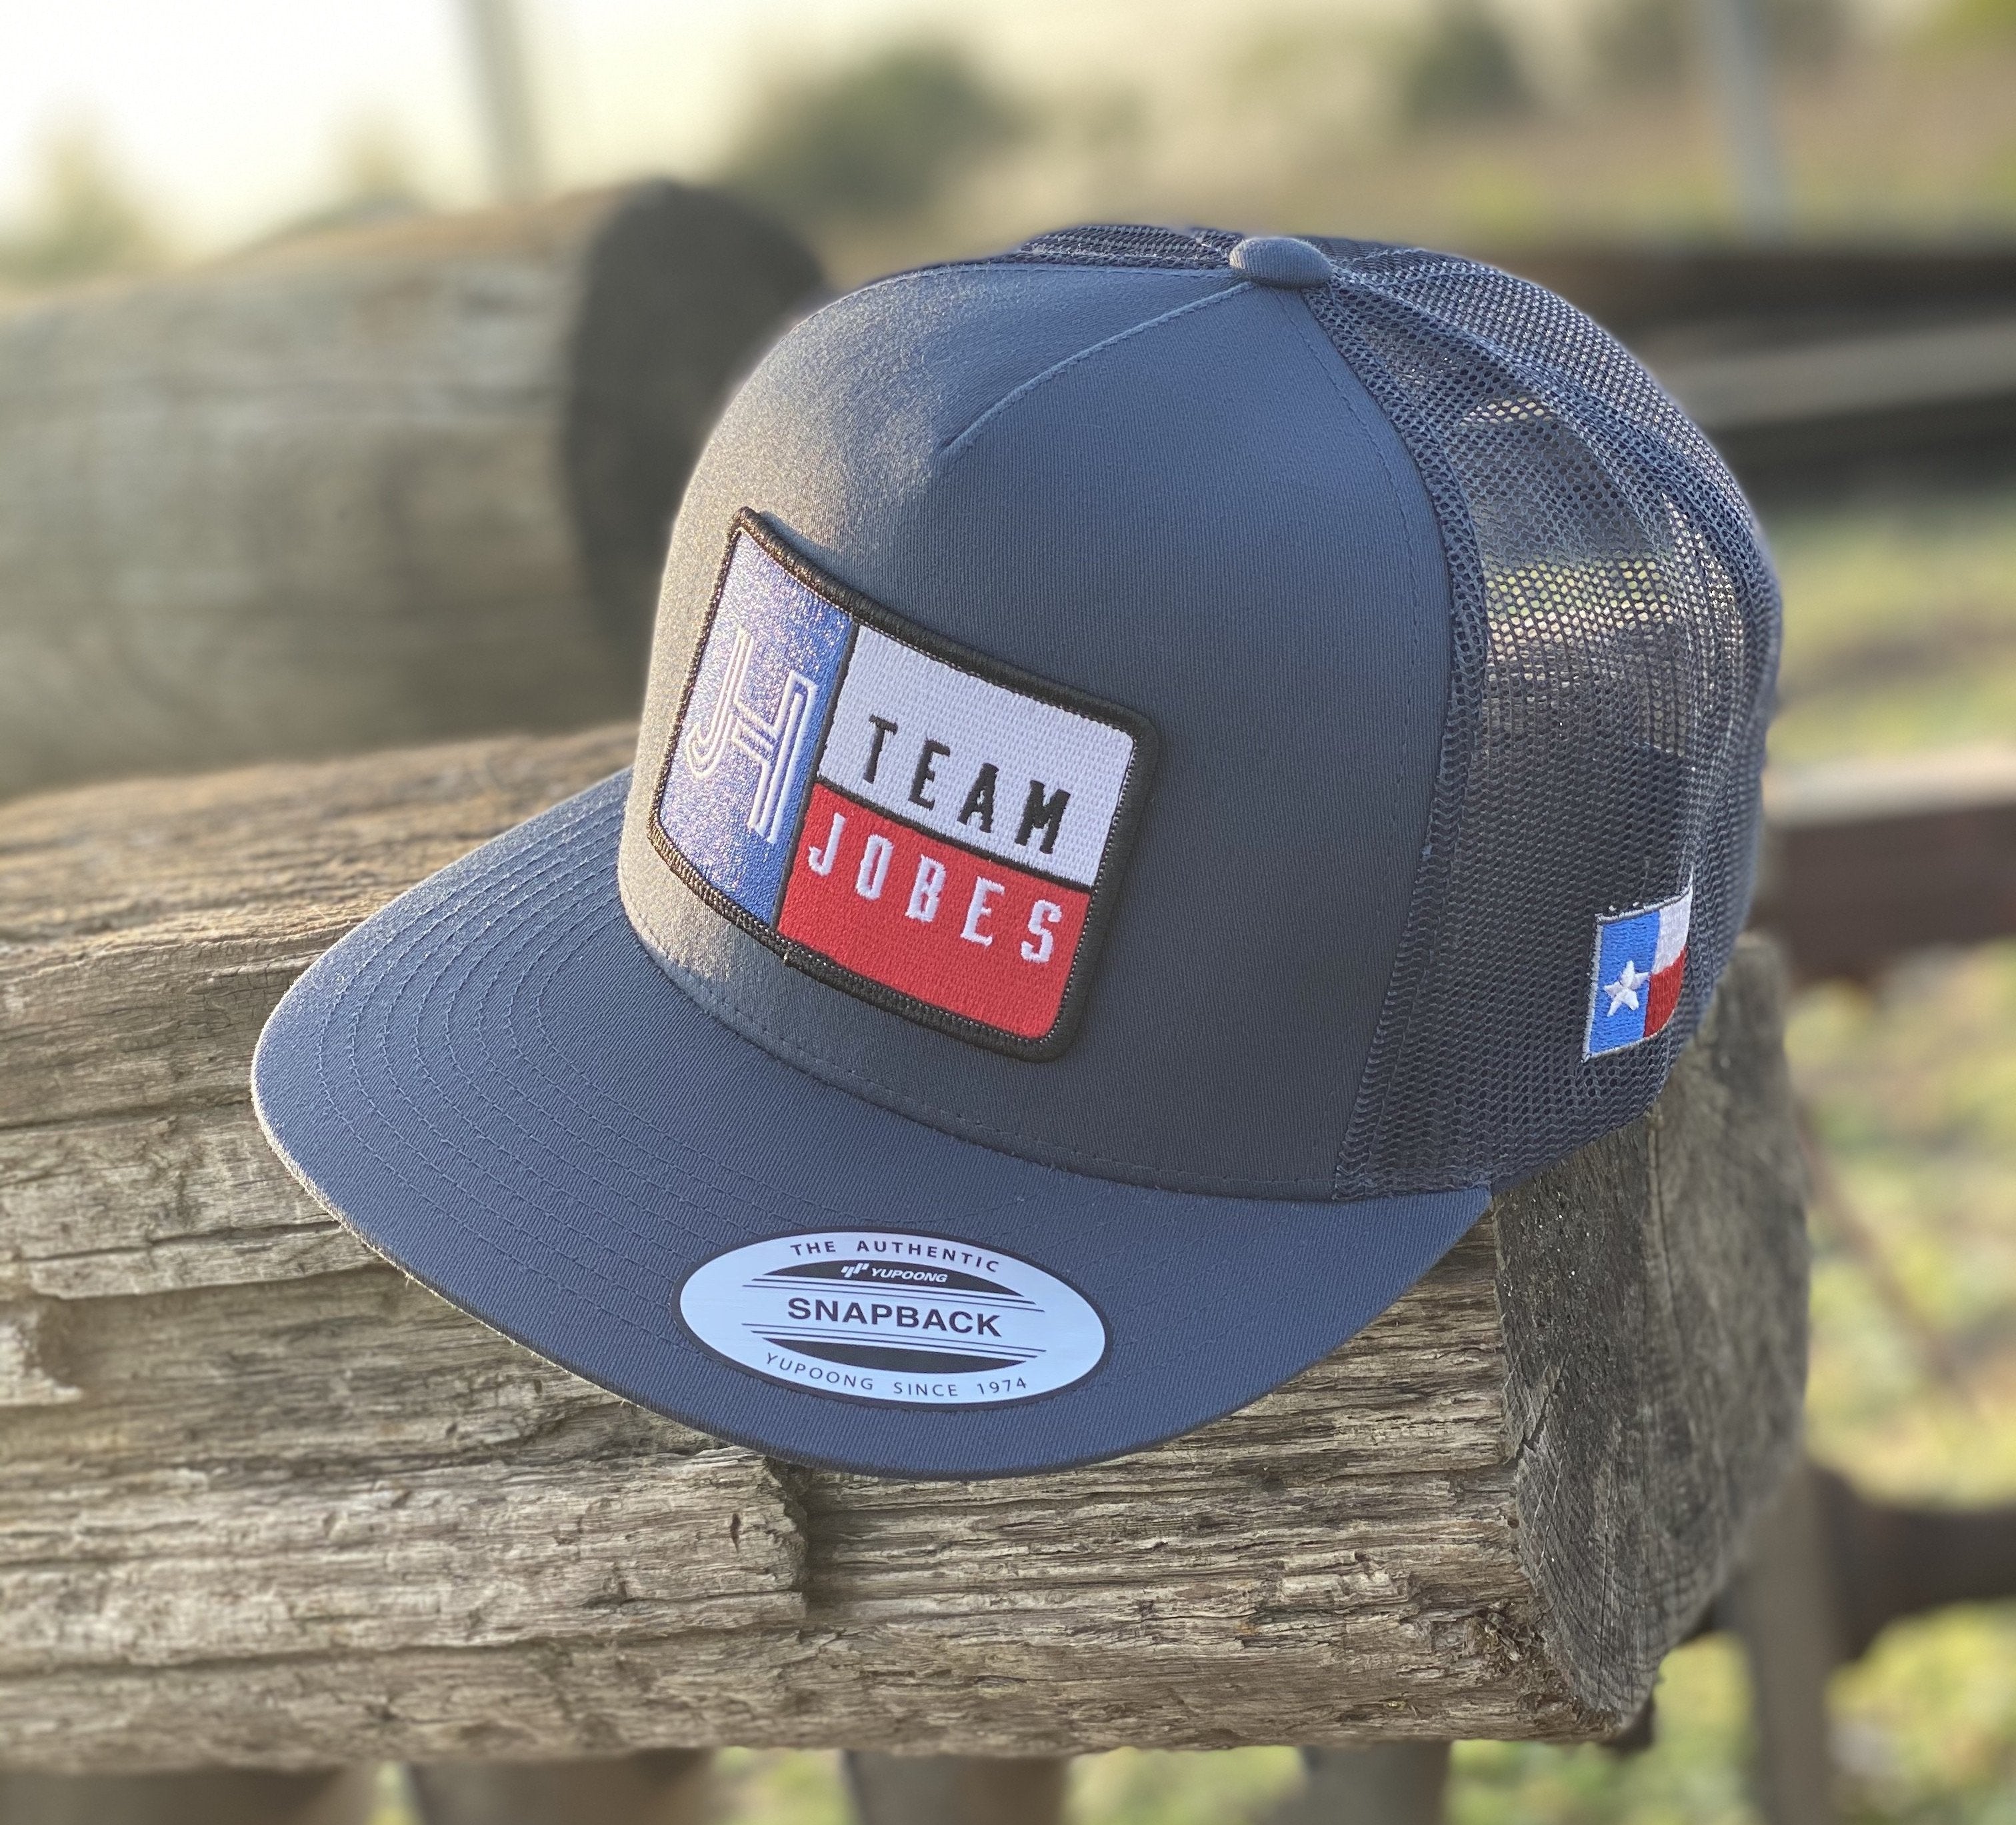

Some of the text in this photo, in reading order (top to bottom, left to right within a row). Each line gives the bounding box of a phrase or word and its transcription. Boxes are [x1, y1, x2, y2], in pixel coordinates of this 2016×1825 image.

[863, 714, 1072, 855] TEAM
[809, 812, 1063, 964] JOBES
[790, 1240, 1001, 1273] THE AUTHENTIC
[870, 1268, 949, 1284] YUPOONG
[787, 1297, 1003, 1338] SNAPBACK
[766, 1352, 1027, 1397] YUPOONG SINCE 1974
